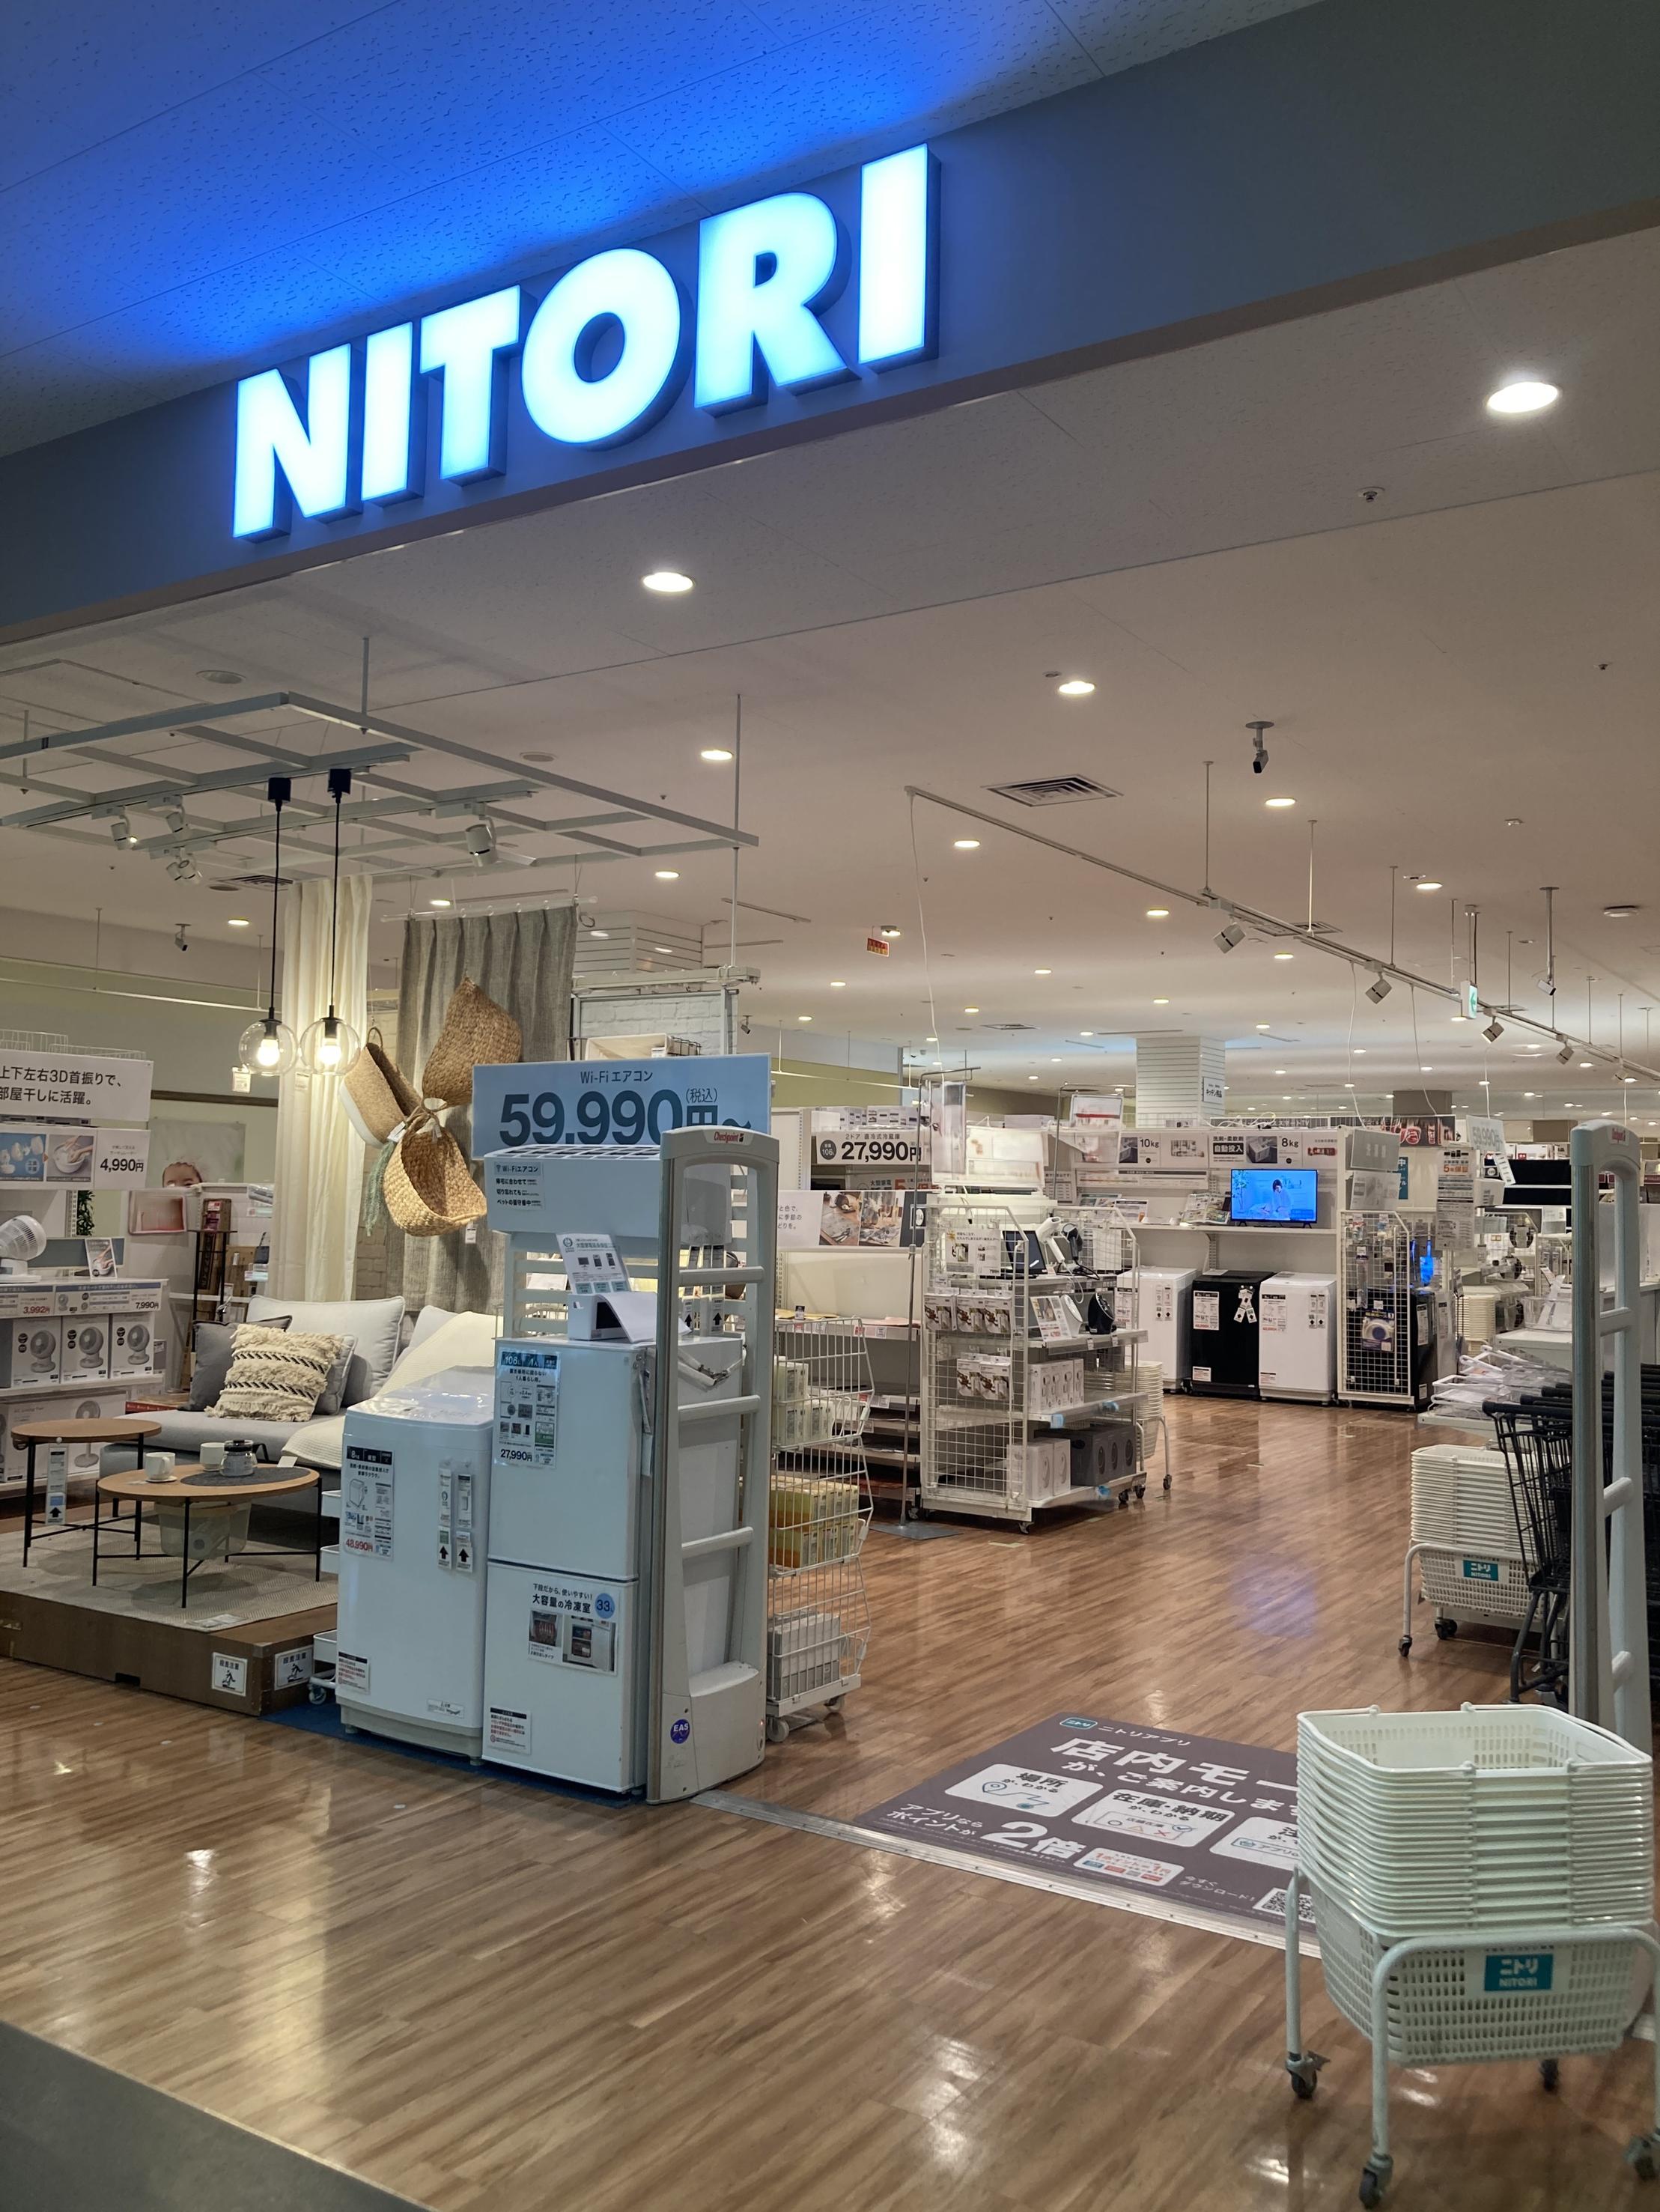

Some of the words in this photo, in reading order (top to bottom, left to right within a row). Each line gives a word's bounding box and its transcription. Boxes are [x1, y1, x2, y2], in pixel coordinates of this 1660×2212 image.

[233, 142, 928, 538] NITORI
[0, 1066, 121, 1087] 上下左右3D首振りで、
[0, 1087, 92, 1105] 部屋干しに活躍。
[1140, 1138, 1160, 1148] 10kg
[1214, 1145, 1244, 1153] 自動投入
[1281, 1137, 1299, 1148] 8kg
[841, 1140, 922, 1162] 27,990円
[100, 1158, 144, 1173] 4,990円
[136, 1301, 159, 1310] 7,990円
[500, 1449, 532, 1462] 27,990円
[346, 1539, 374, 1552] 48,990円
[1471, 1563, 1491, 1573] ニトリ
[532, 1593, 592, 1614] 大容量の冷凍室
[596, 1599, 615, 1612] 33L
[673, 1723, 689, 1732] EAS
[1098, 1725, 1191, 1745] ニトリアプリ
[1016, 1772, 1068, 1787] 場所
[1113, 1792, 1229, 1821] 在庫・納期
[887, 1811, 976, 1835] ポイントが
[901, 1803, 983, 1828] アプリなら
[980, 1821, 1086, 1859] 2倍
[1500, 1958, 1538, 1975] ニトリ
[1499, 1977, 1538, 1987] NITORI
